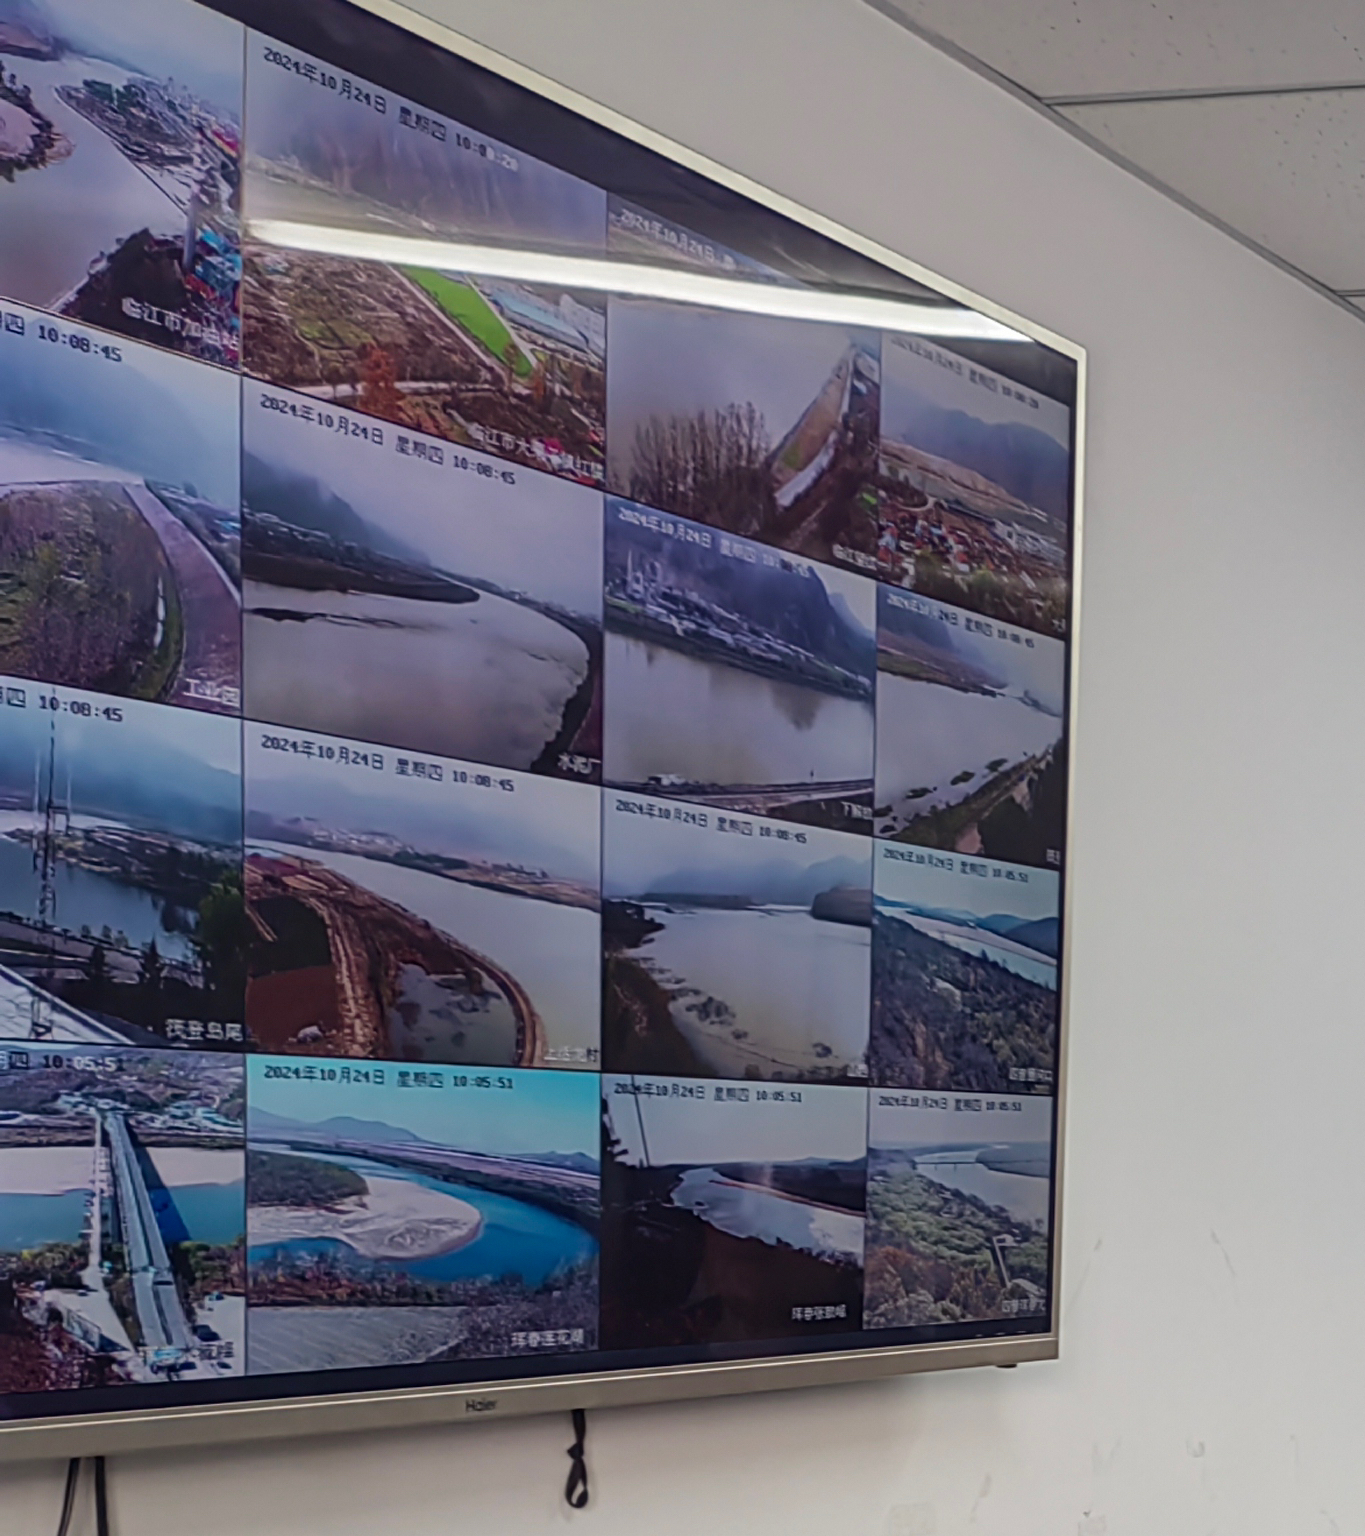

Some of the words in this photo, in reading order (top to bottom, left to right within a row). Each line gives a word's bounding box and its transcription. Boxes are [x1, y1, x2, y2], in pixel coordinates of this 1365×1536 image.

[264, 46, 386, 114] 2024年10月24日
[400, 106, 447, 142] 星期四
[38, 324, 122, 363] 10:08:45
[260, 394, 383, 446] 2024年10月24日
[396, 435, 444, 466] 星期四
[38, 694, 124, 723] 10:08:45
[261, 734, 384, 771] 2024年10月24日
[396, 757, 444, 782] 星期四
[452, 769, 515, 793] 10:08:45
[42, 1054, 126, 1073] 10:05:51
[263, 1064, 386, 1086] 2024年10月24日
[397, 1070, 445, 1089] 星期四
[452, 1074, 515, 1090] 10:05:51
